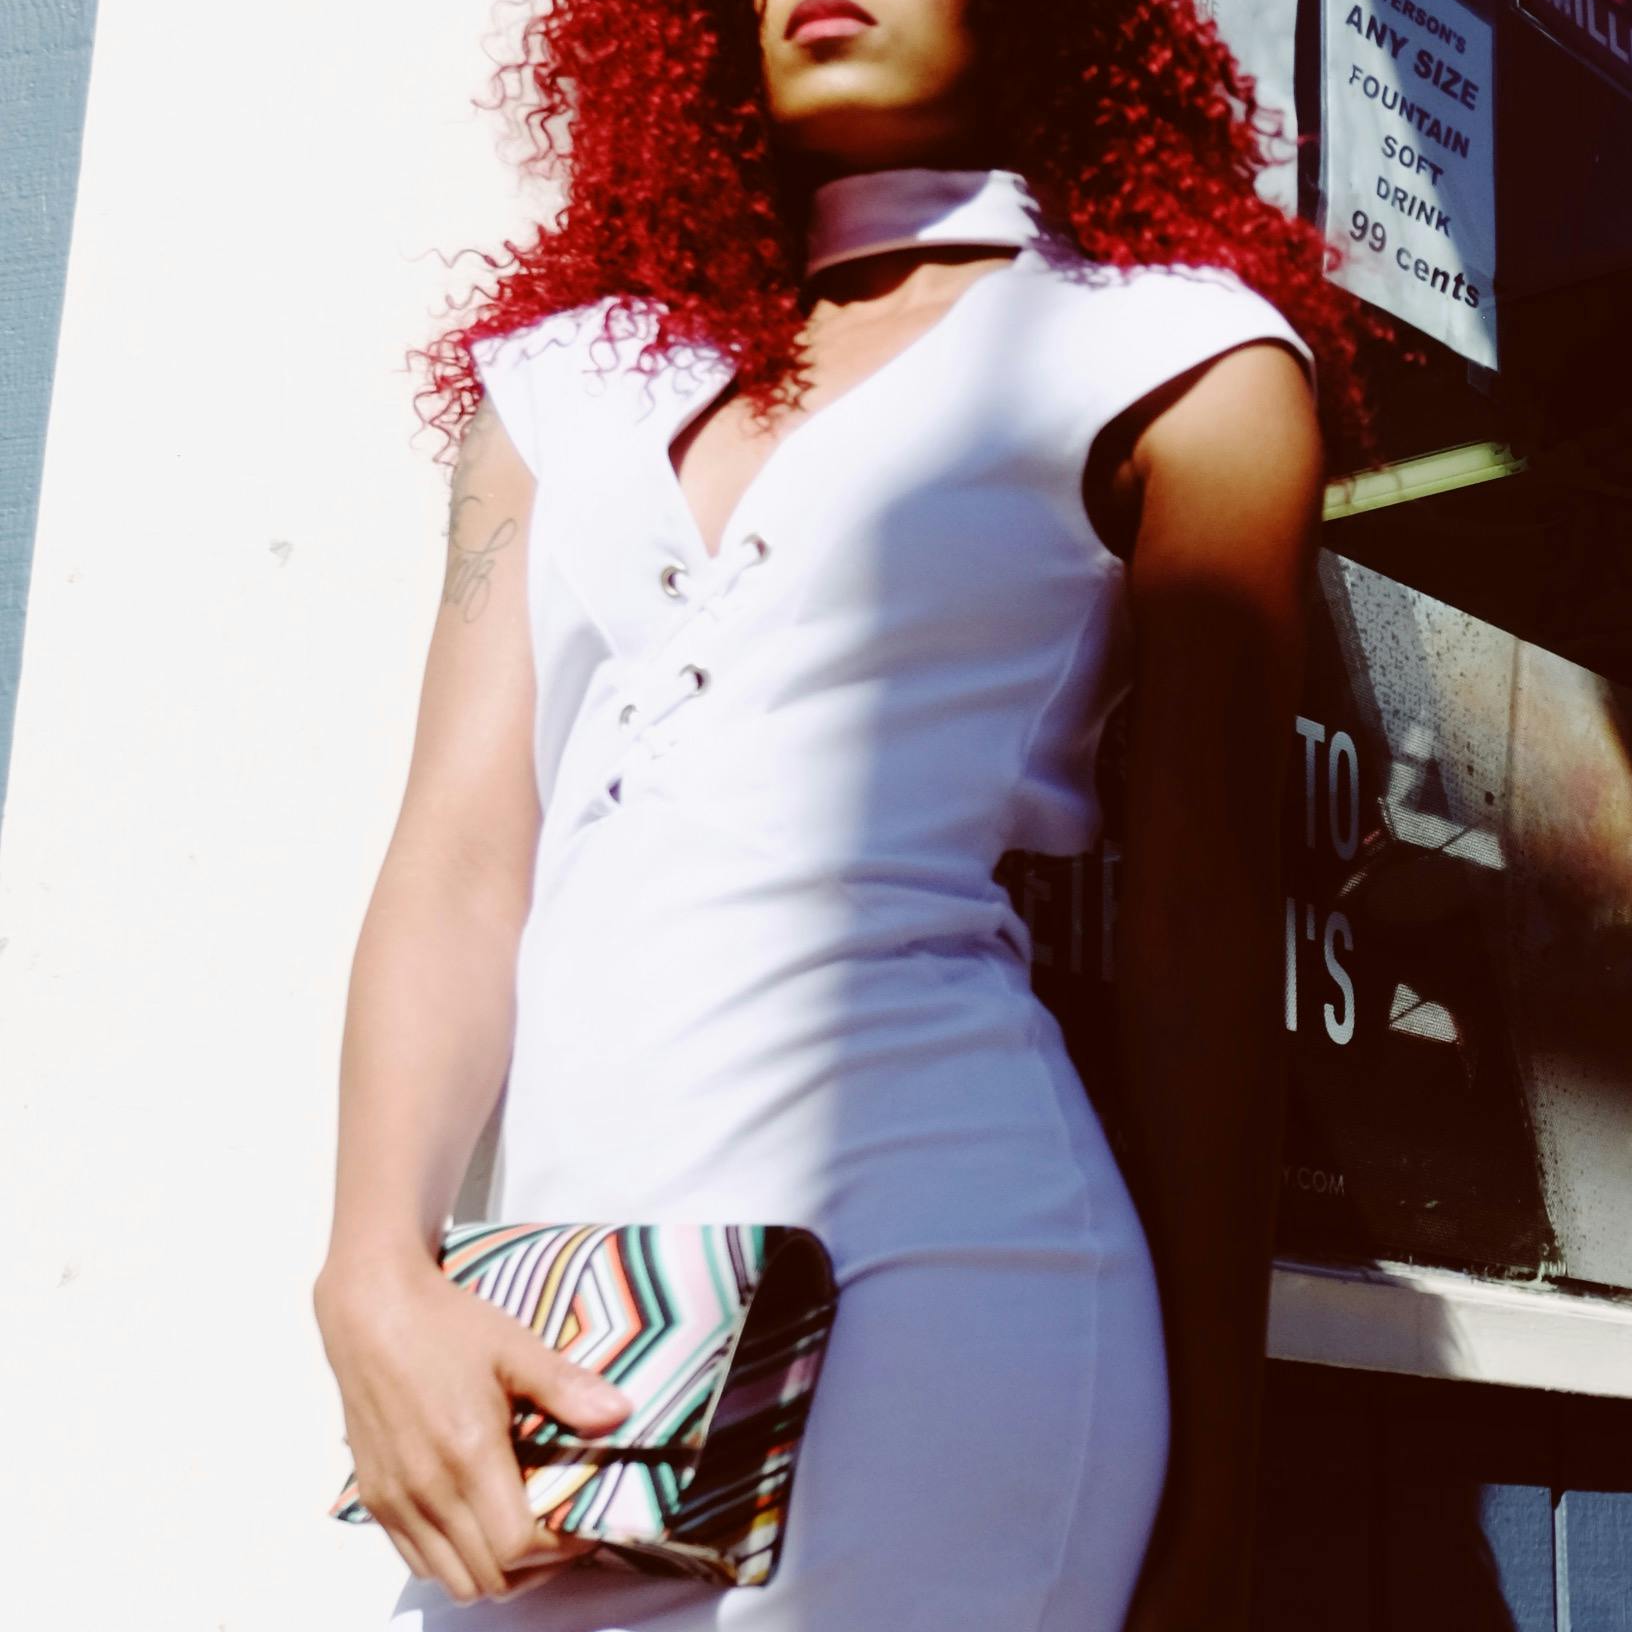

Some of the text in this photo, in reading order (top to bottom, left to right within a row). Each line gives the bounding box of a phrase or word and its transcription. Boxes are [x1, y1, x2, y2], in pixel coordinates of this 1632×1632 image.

[1345, 3, 1479, 111] ANY SIZE
[1350, 63, 1470, 160] FOUNTAIN
[1376, 175, 1451, 236] DRINK
[1381, 134, 1445, 188] SOFT
[1350, 210, 1481, 309] 99 cents
[1295, 714, 1360, 861] TO
